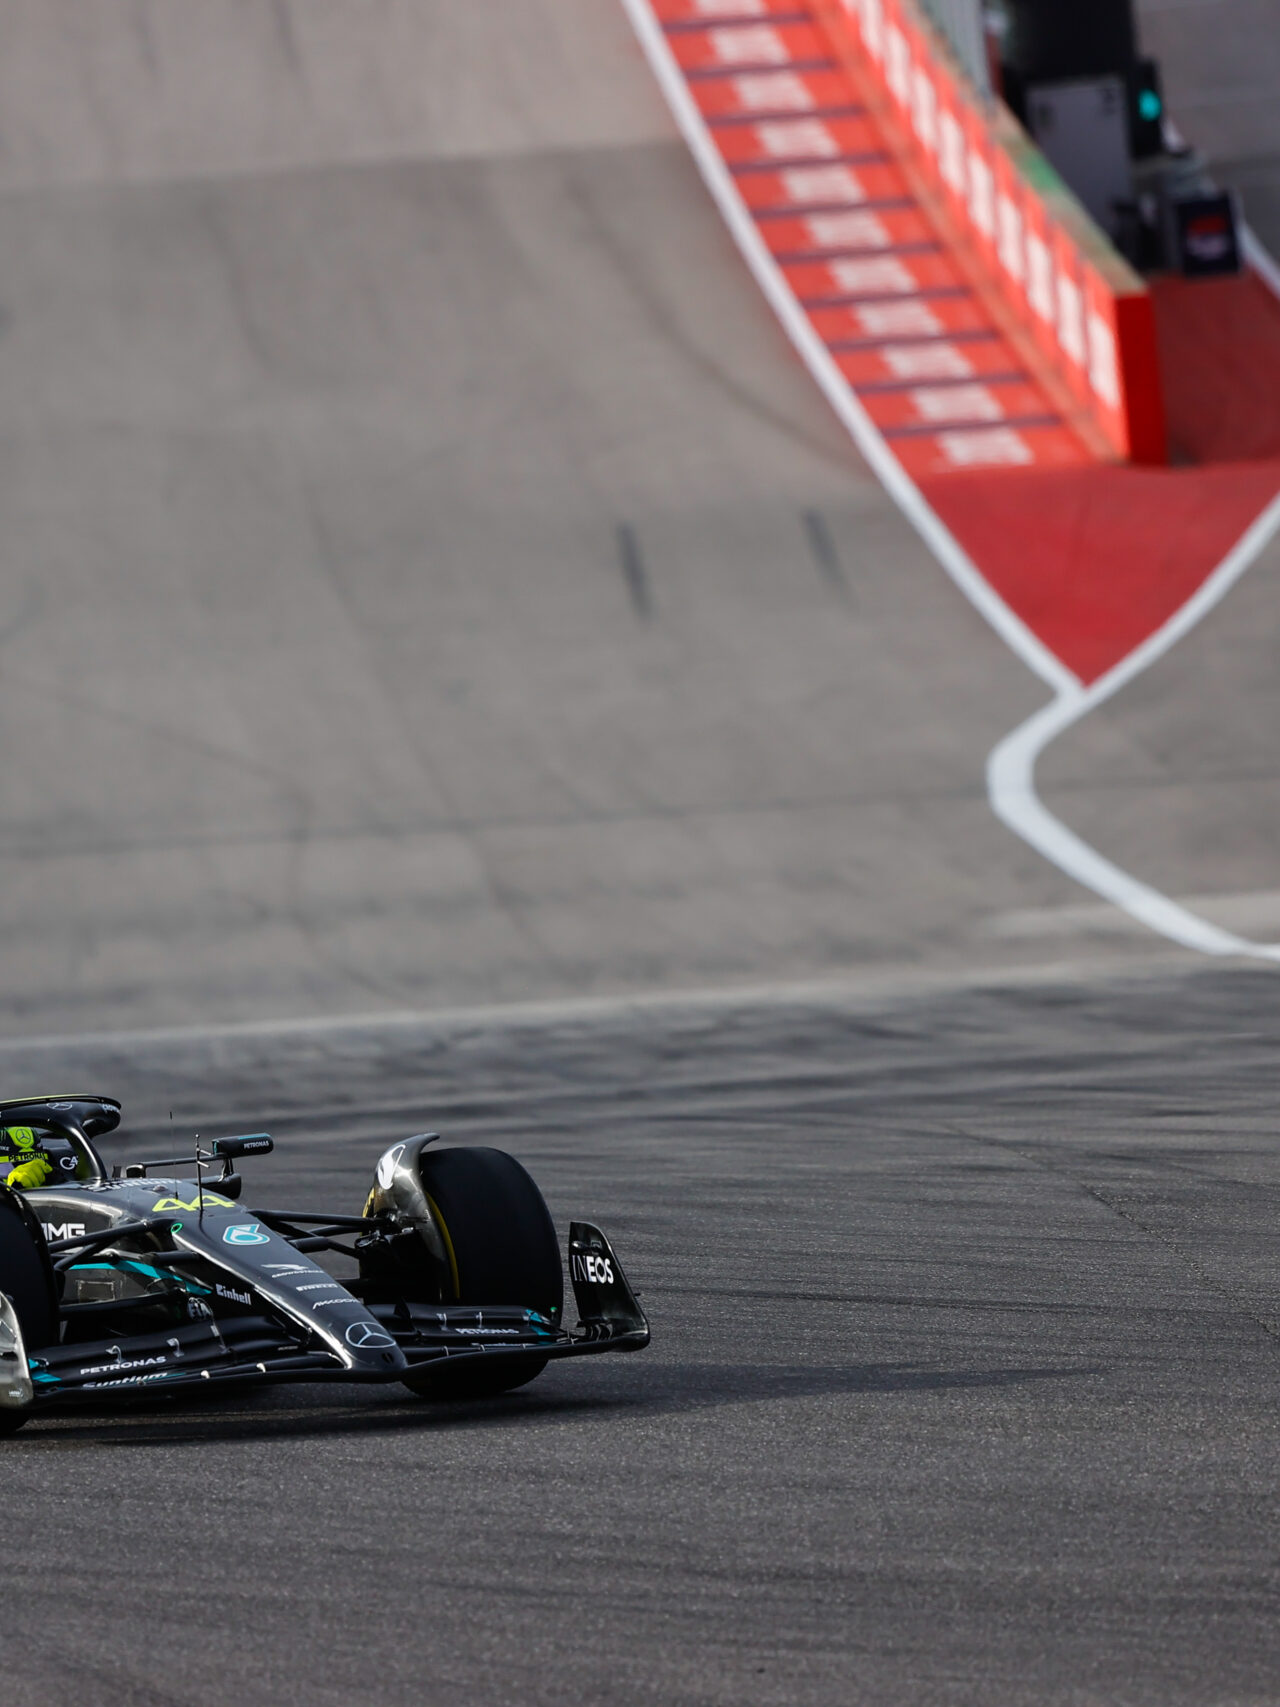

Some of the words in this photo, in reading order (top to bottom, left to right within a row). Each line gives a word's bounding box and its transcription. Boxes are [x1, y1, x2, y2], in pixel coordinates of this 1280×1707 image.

[243, 1141, 270, 1150] PETRONAS
[59, 1156, 79, 1171] G4
[152, 1195, 237, 1212] 44
[572, 1254, 614, 1284] INEOS
[215, 1283, 252, 1306] Einhell
[80, 1356, 167, 1375] PETRONAS
